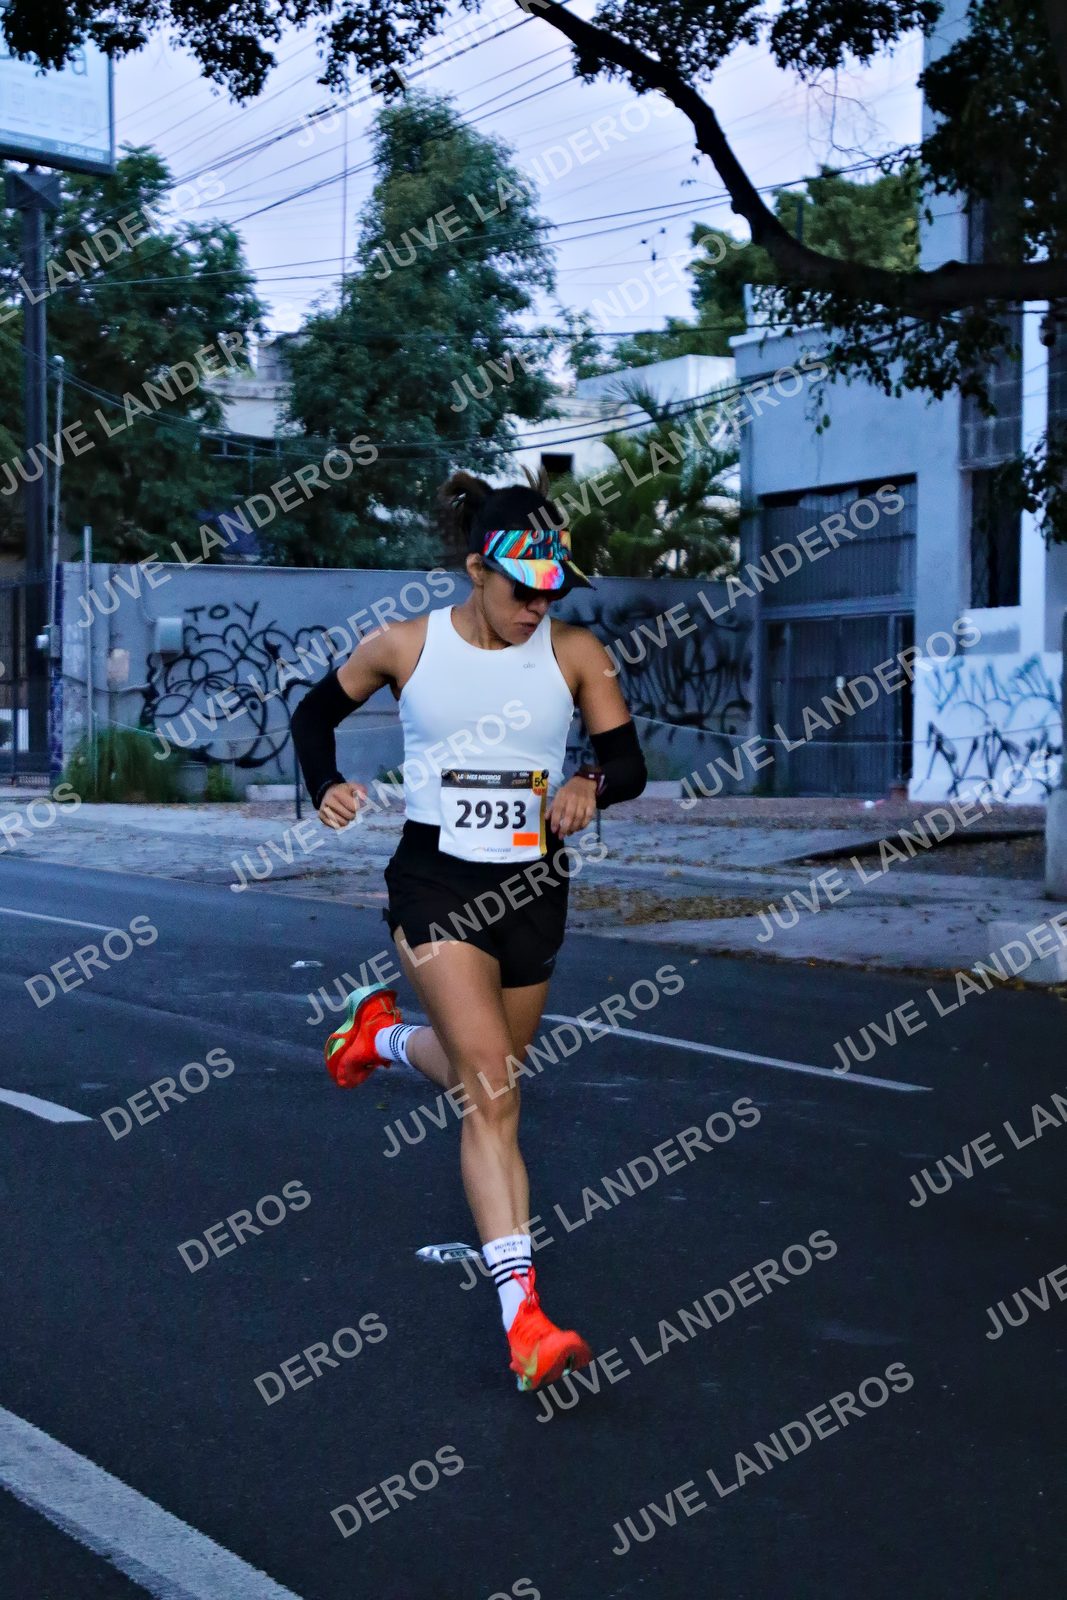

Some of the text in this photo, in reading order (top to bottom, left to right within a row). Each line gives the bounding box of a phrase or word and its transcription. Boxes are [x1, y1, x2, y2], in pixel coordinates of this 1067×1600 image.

[184, 601, 259, 629] TOY
[534, 778, 545, 787] 5K
[455, 799, 526, 830] 2933
